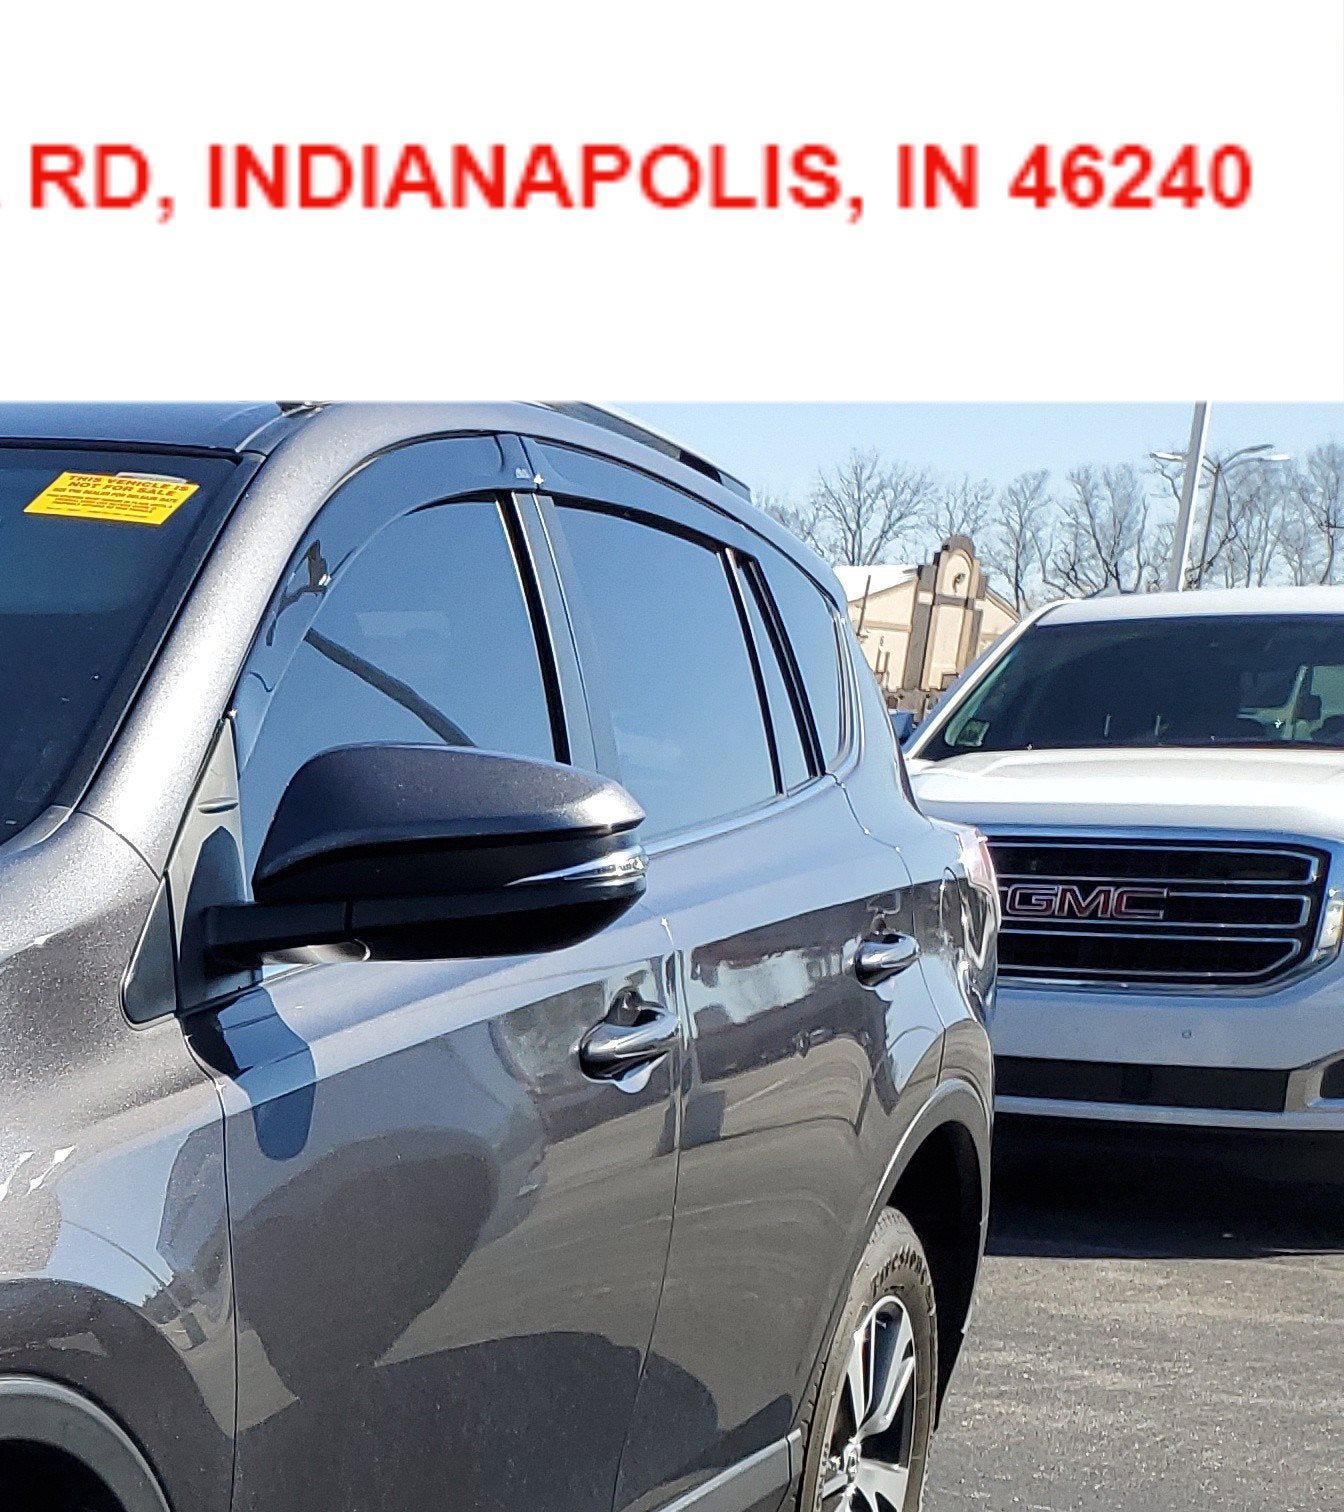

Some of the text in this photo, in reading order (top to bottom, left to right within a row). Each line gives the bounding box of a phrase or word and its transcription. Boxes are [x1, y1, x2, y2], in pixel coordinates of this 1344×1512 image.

[68, 481, 101, 490] NOT
[136, 487, 176, 497] SALE
[69, 475, 102, 483] THIS
[107, 476, 171, 488] VEHICLE
[1006, 883, 1169, 920] GMC
